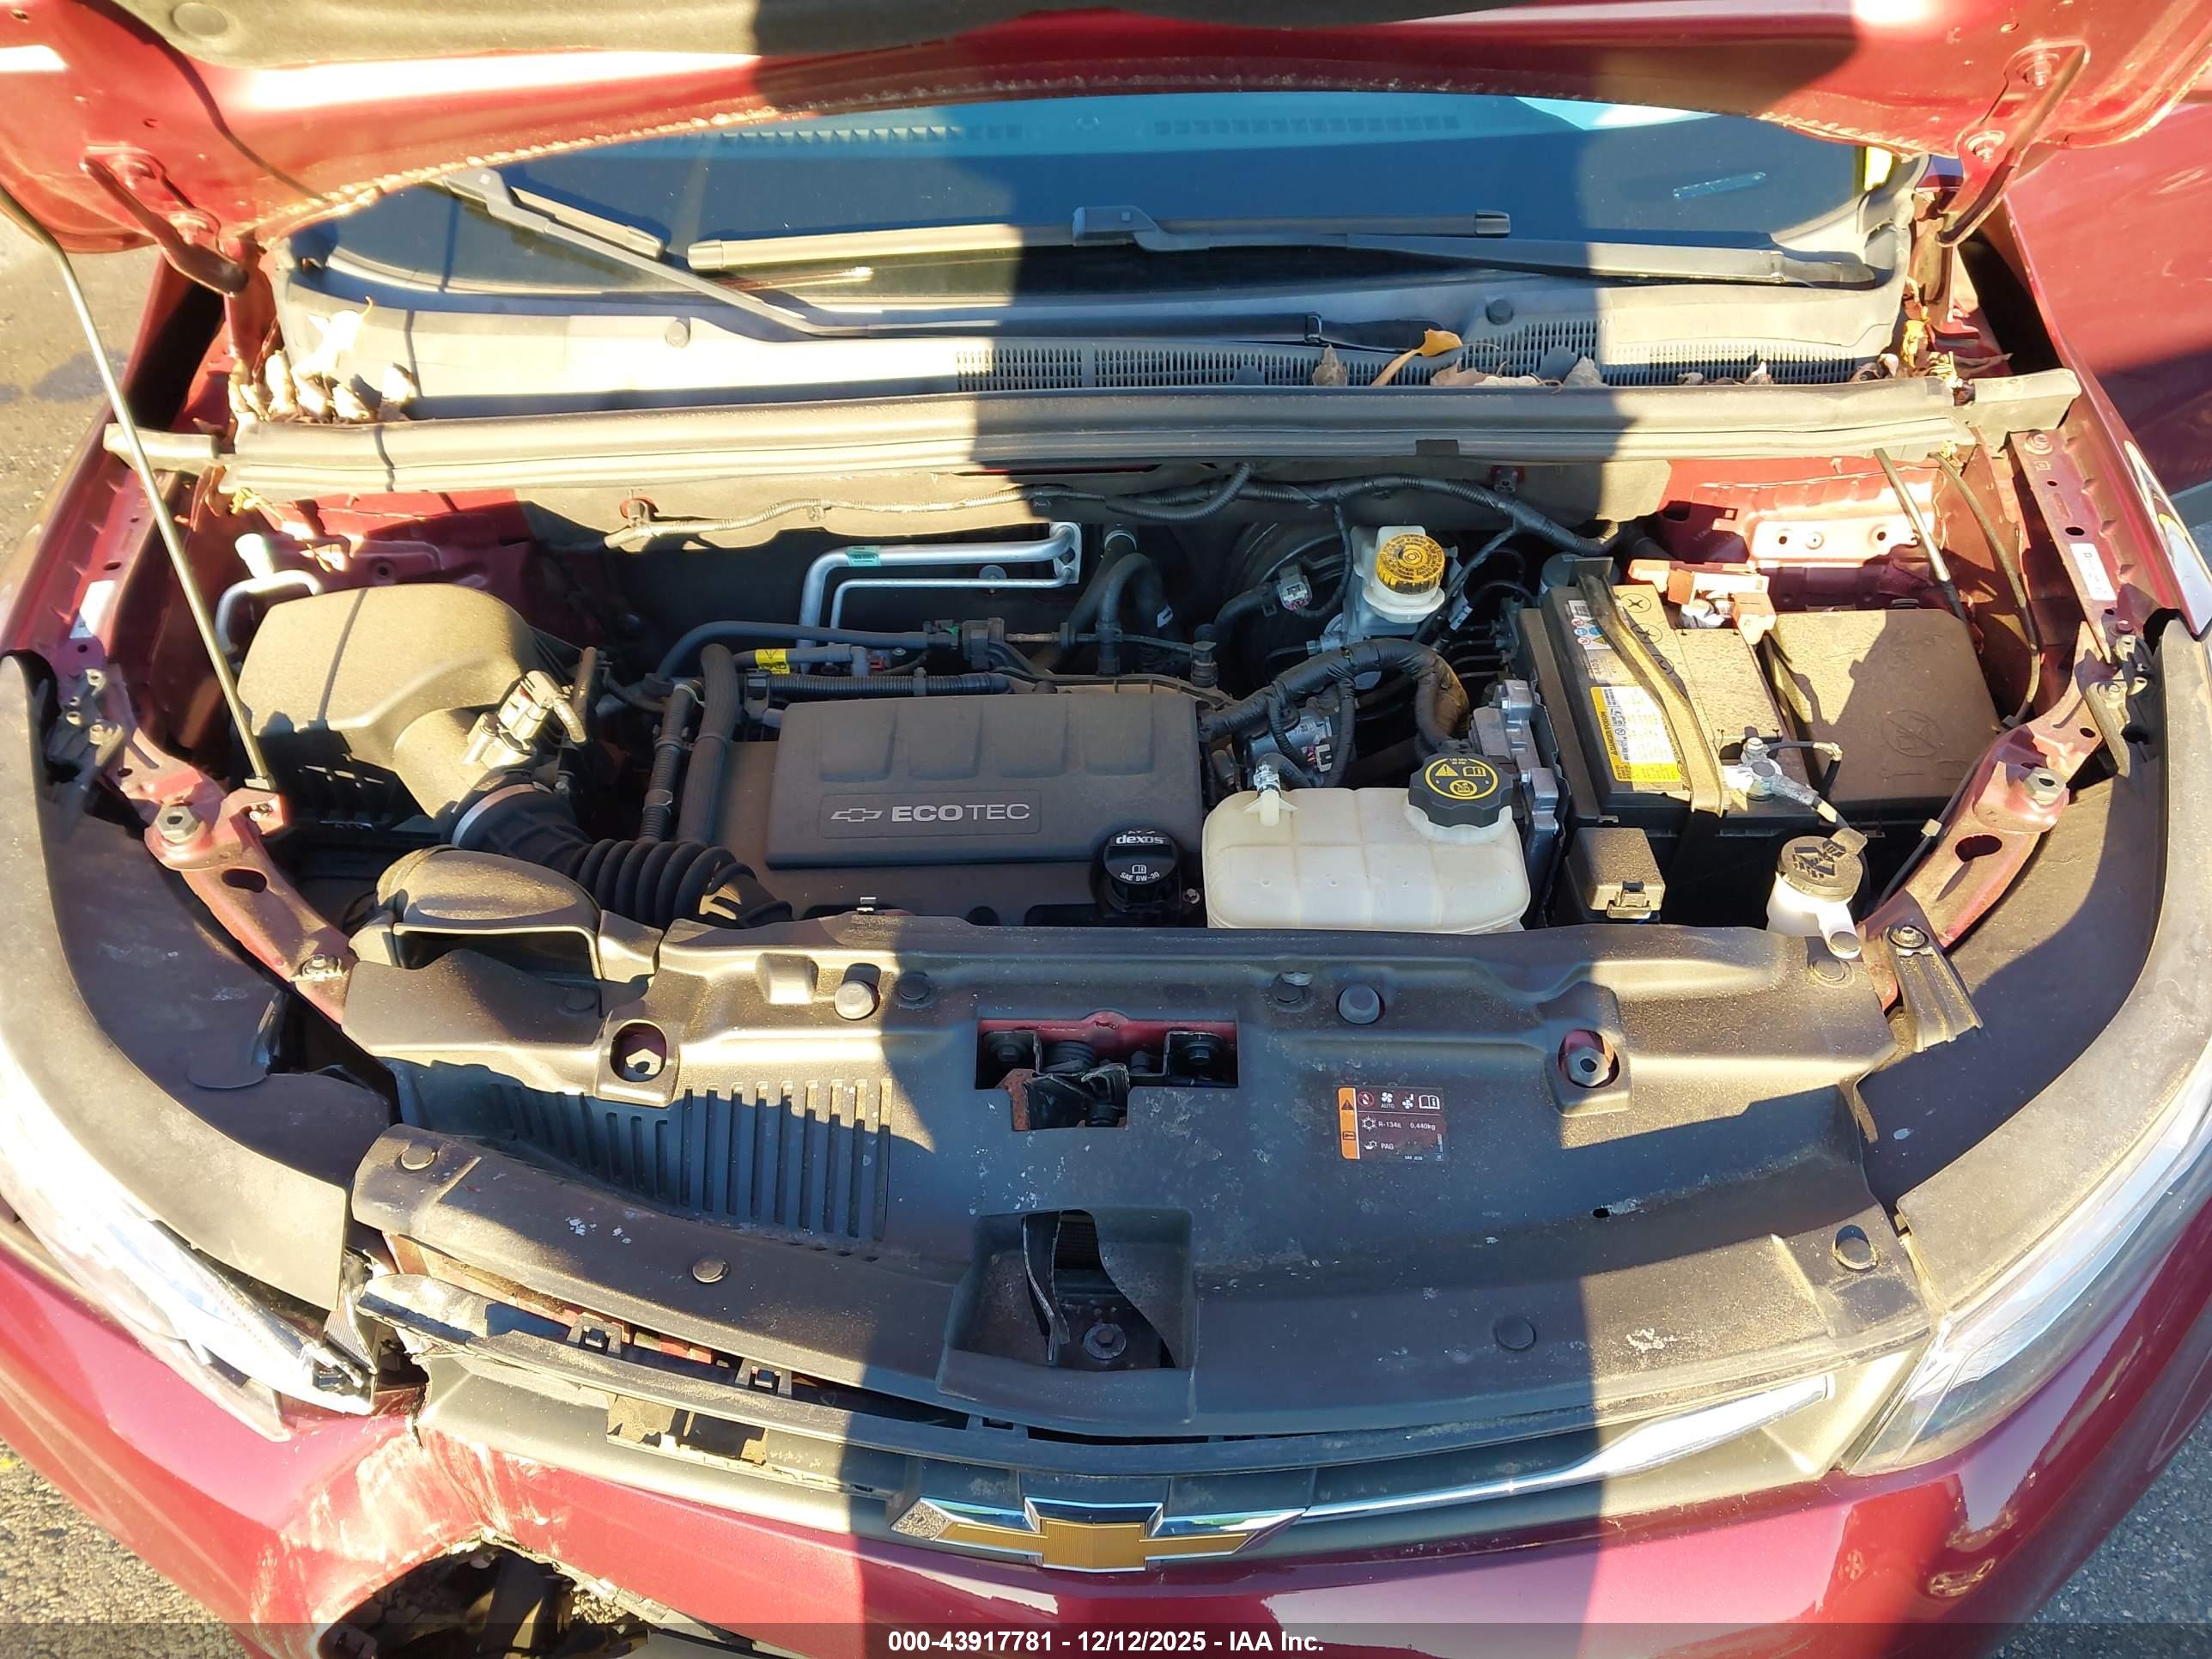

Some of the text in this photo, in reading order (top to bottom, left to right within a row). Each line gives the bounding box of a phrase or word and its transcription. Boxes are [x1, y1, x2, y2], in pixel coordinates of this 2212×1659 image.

[890, 803, 1030, 823] ECOTEC
[1116, 835, 1167, 844] dexos
[1120, 871, 1160, 882] SAE 5W-30
[1381, 1142, 1395, 1151] PAG
